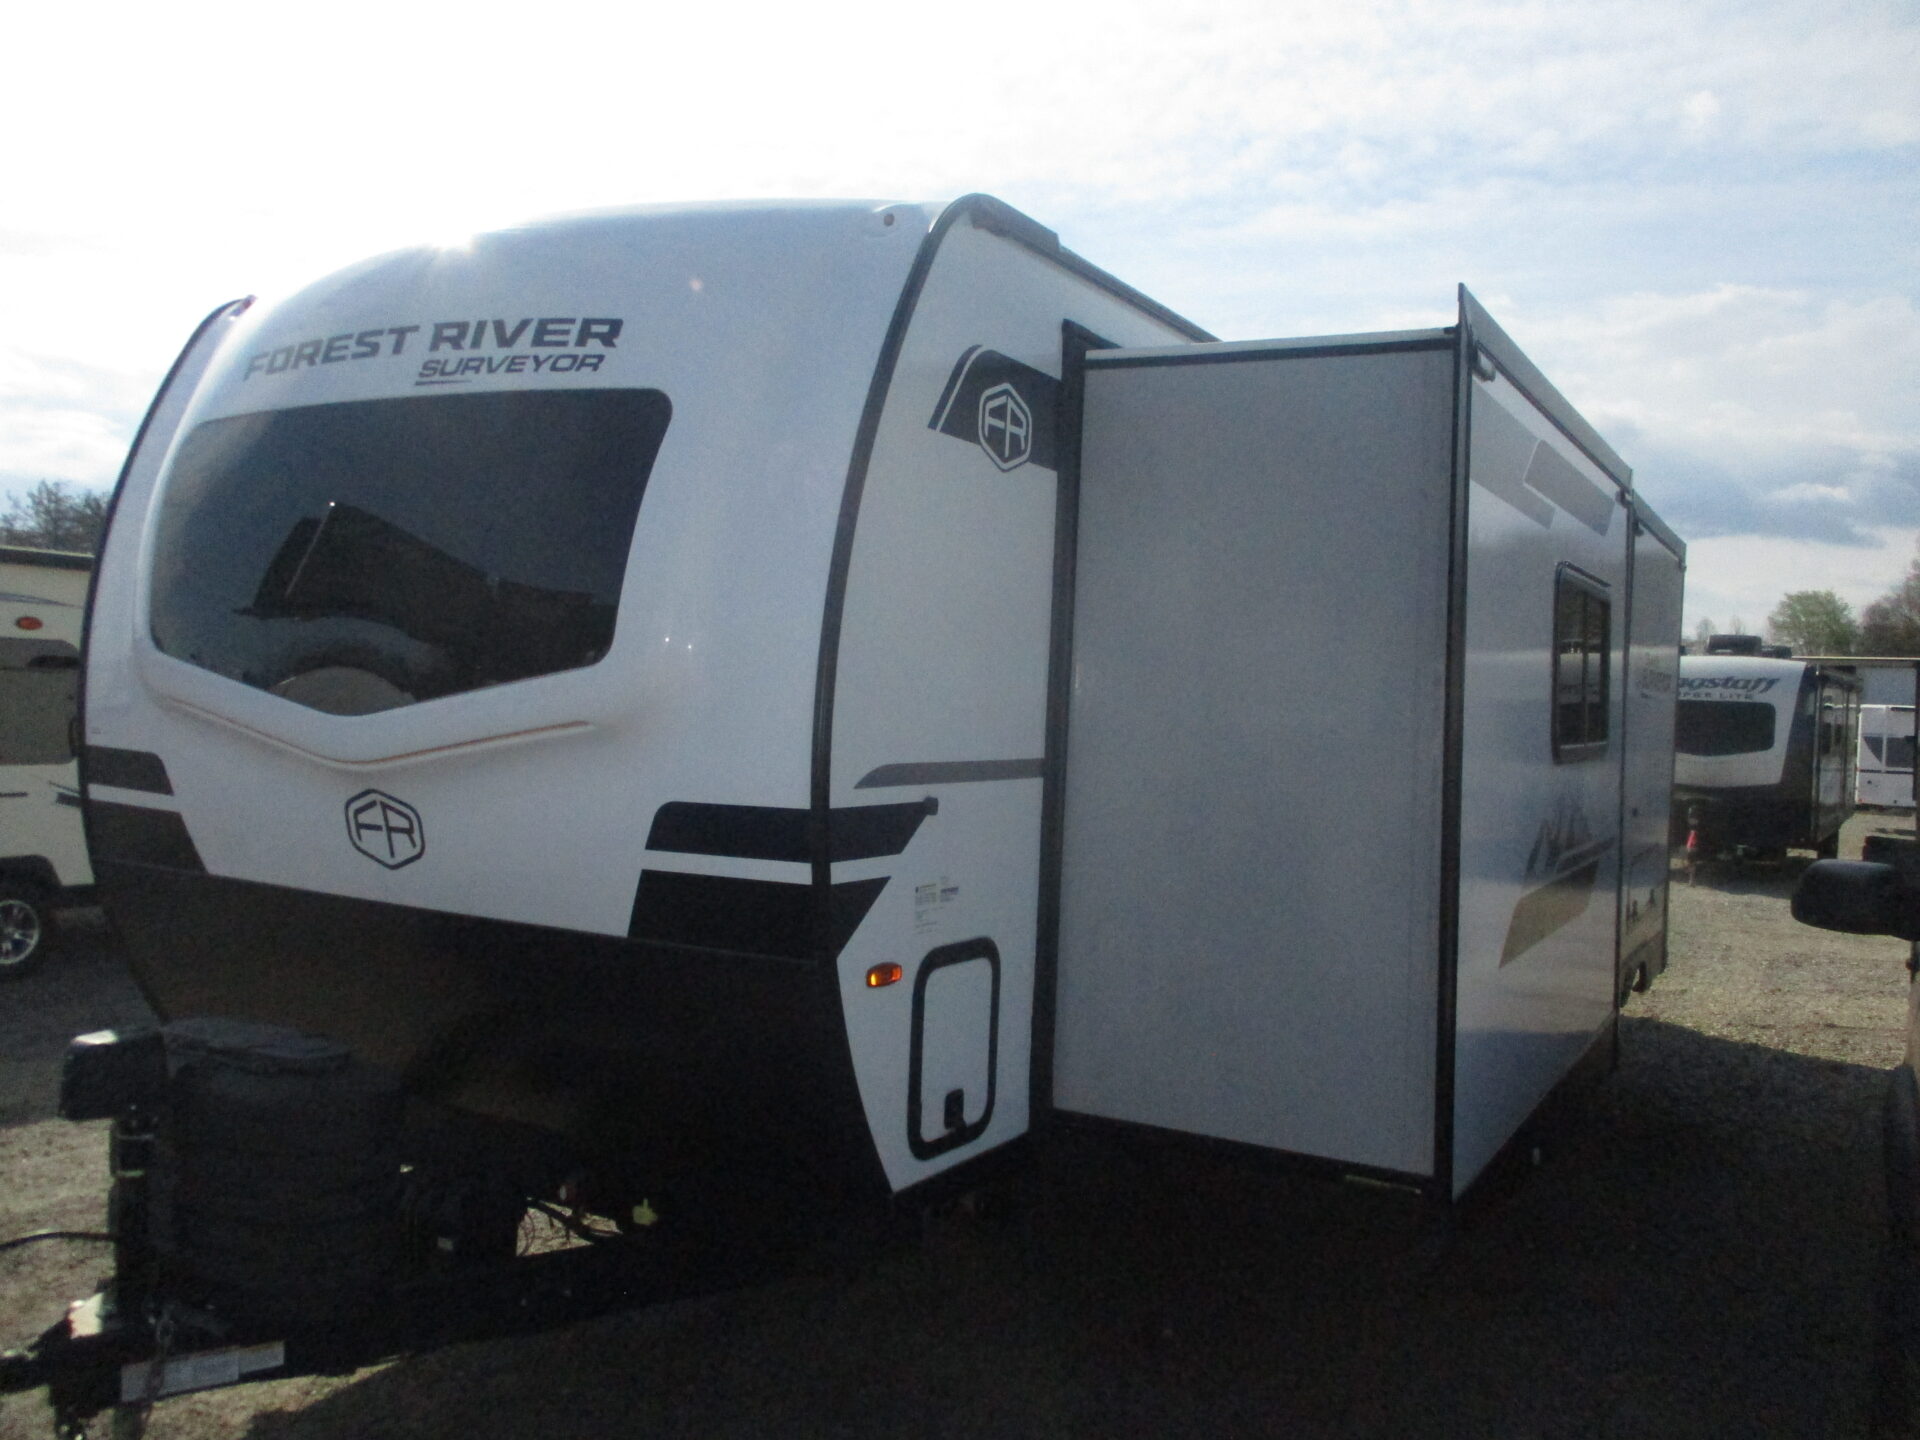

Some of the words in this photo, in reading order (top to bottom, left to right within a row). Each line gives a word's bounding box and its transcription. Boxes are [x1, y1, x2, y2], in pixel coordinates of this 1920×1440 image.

[242, 324, 421, 382] FOREST
[429, 317, 624, 352] RIVER
[418, 353, 606, 379] SURVEYOR
